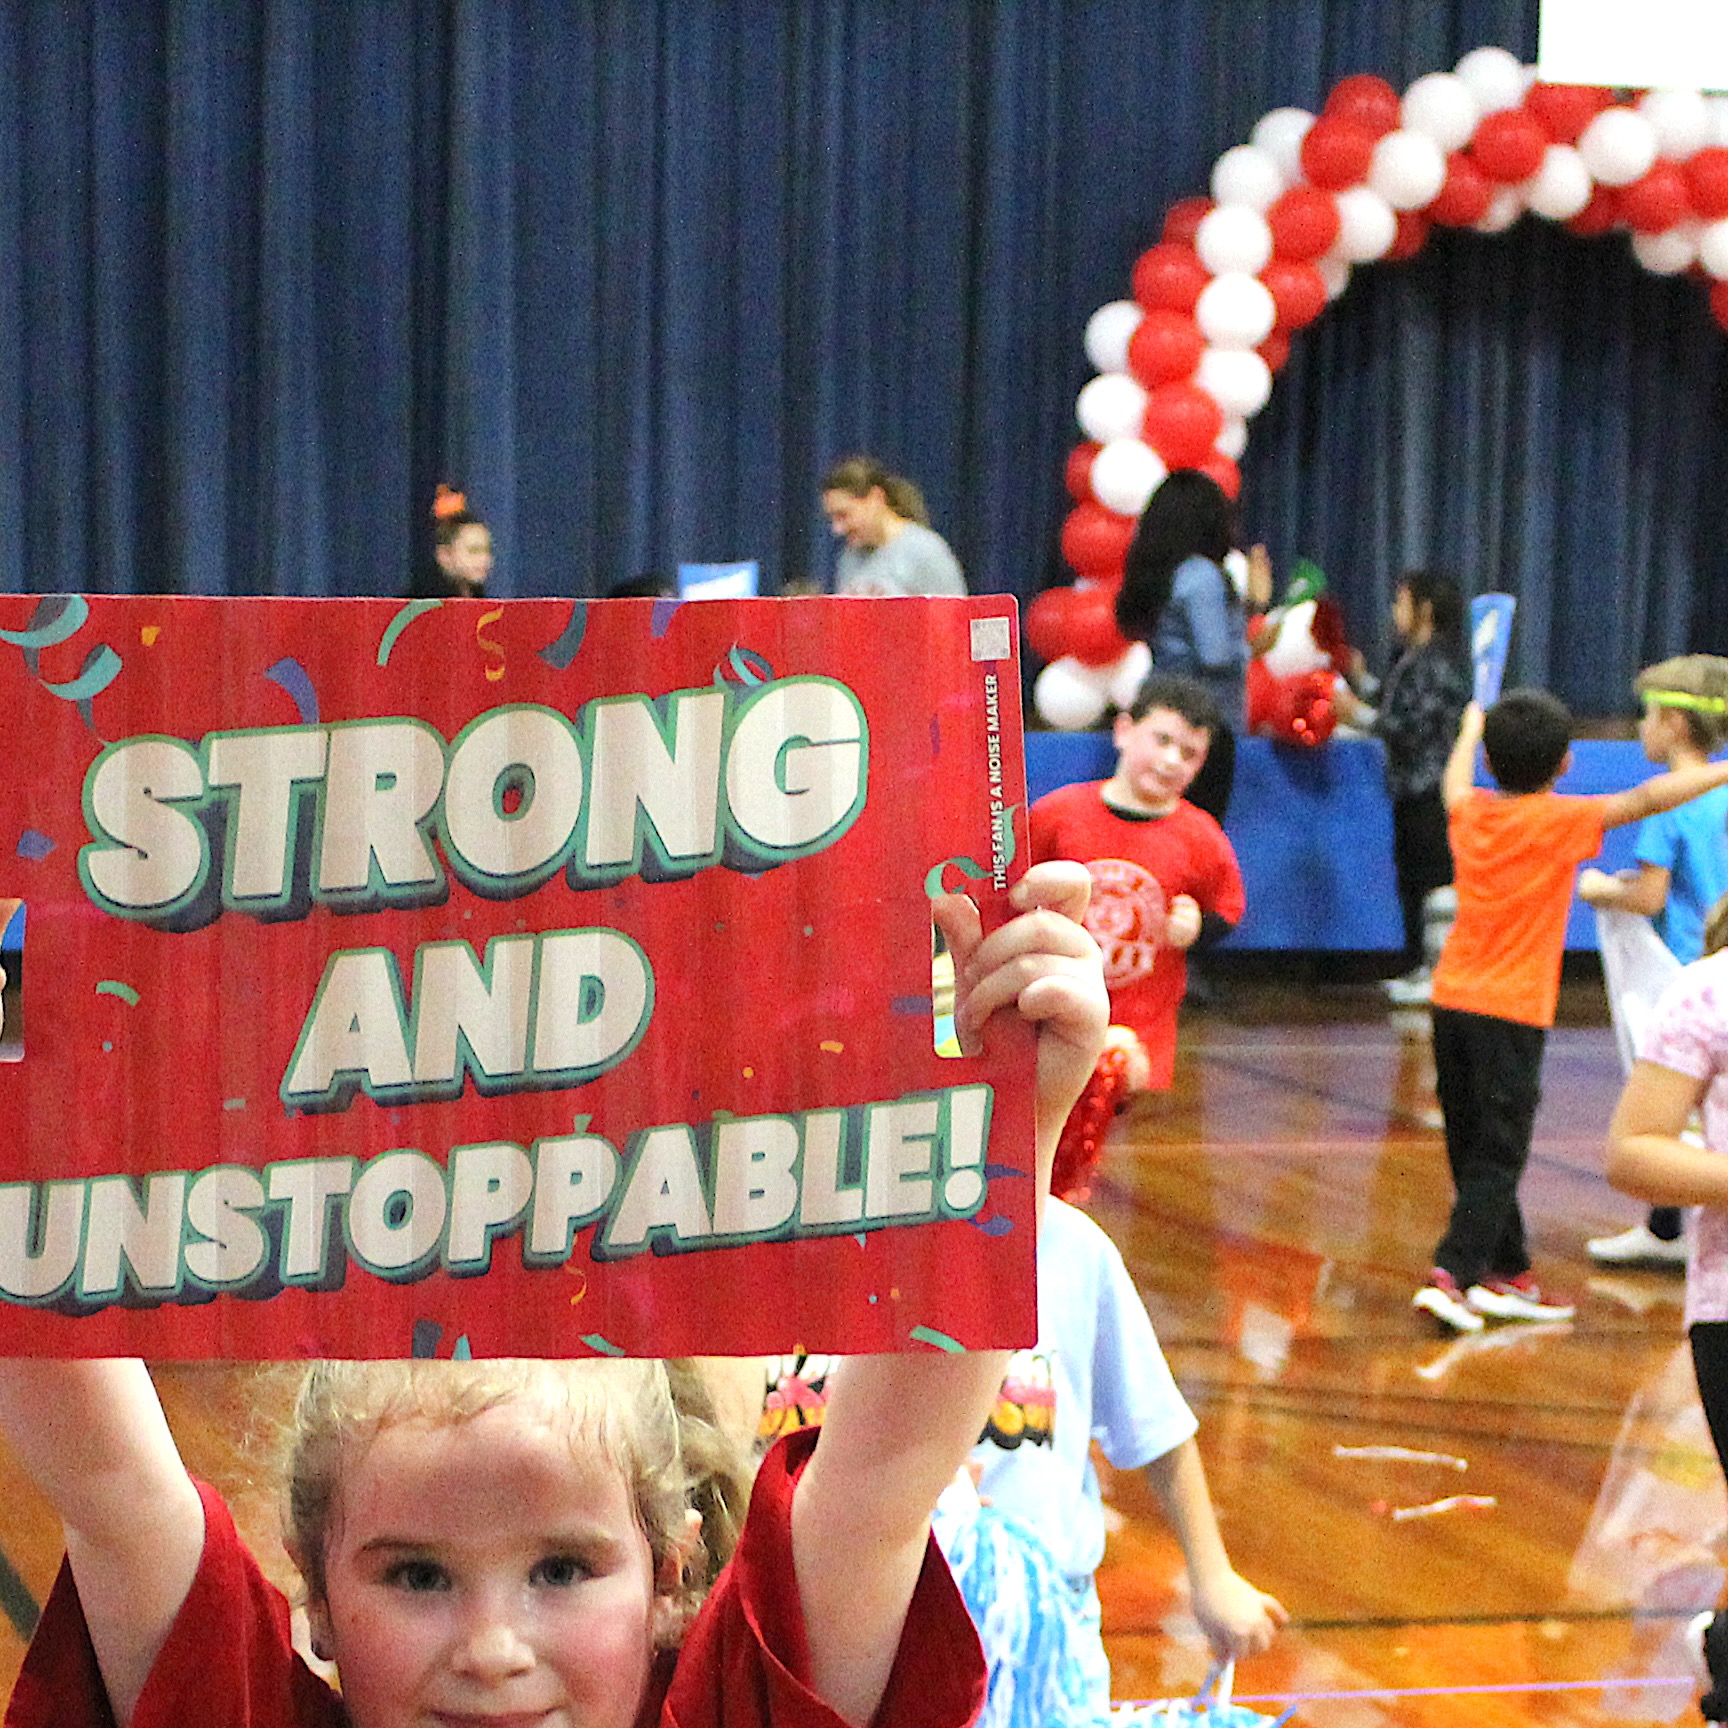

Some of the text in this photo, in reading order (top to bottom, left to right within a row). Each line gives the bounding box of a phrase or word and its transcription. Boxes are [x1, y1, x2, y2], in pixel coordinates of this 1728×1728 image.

[80, 674, 870, 931] STRONG
[984, 674, 1008, 891] THIS FAN IS A NOISE MAKER
[281, 926, 655, 1112] AND
